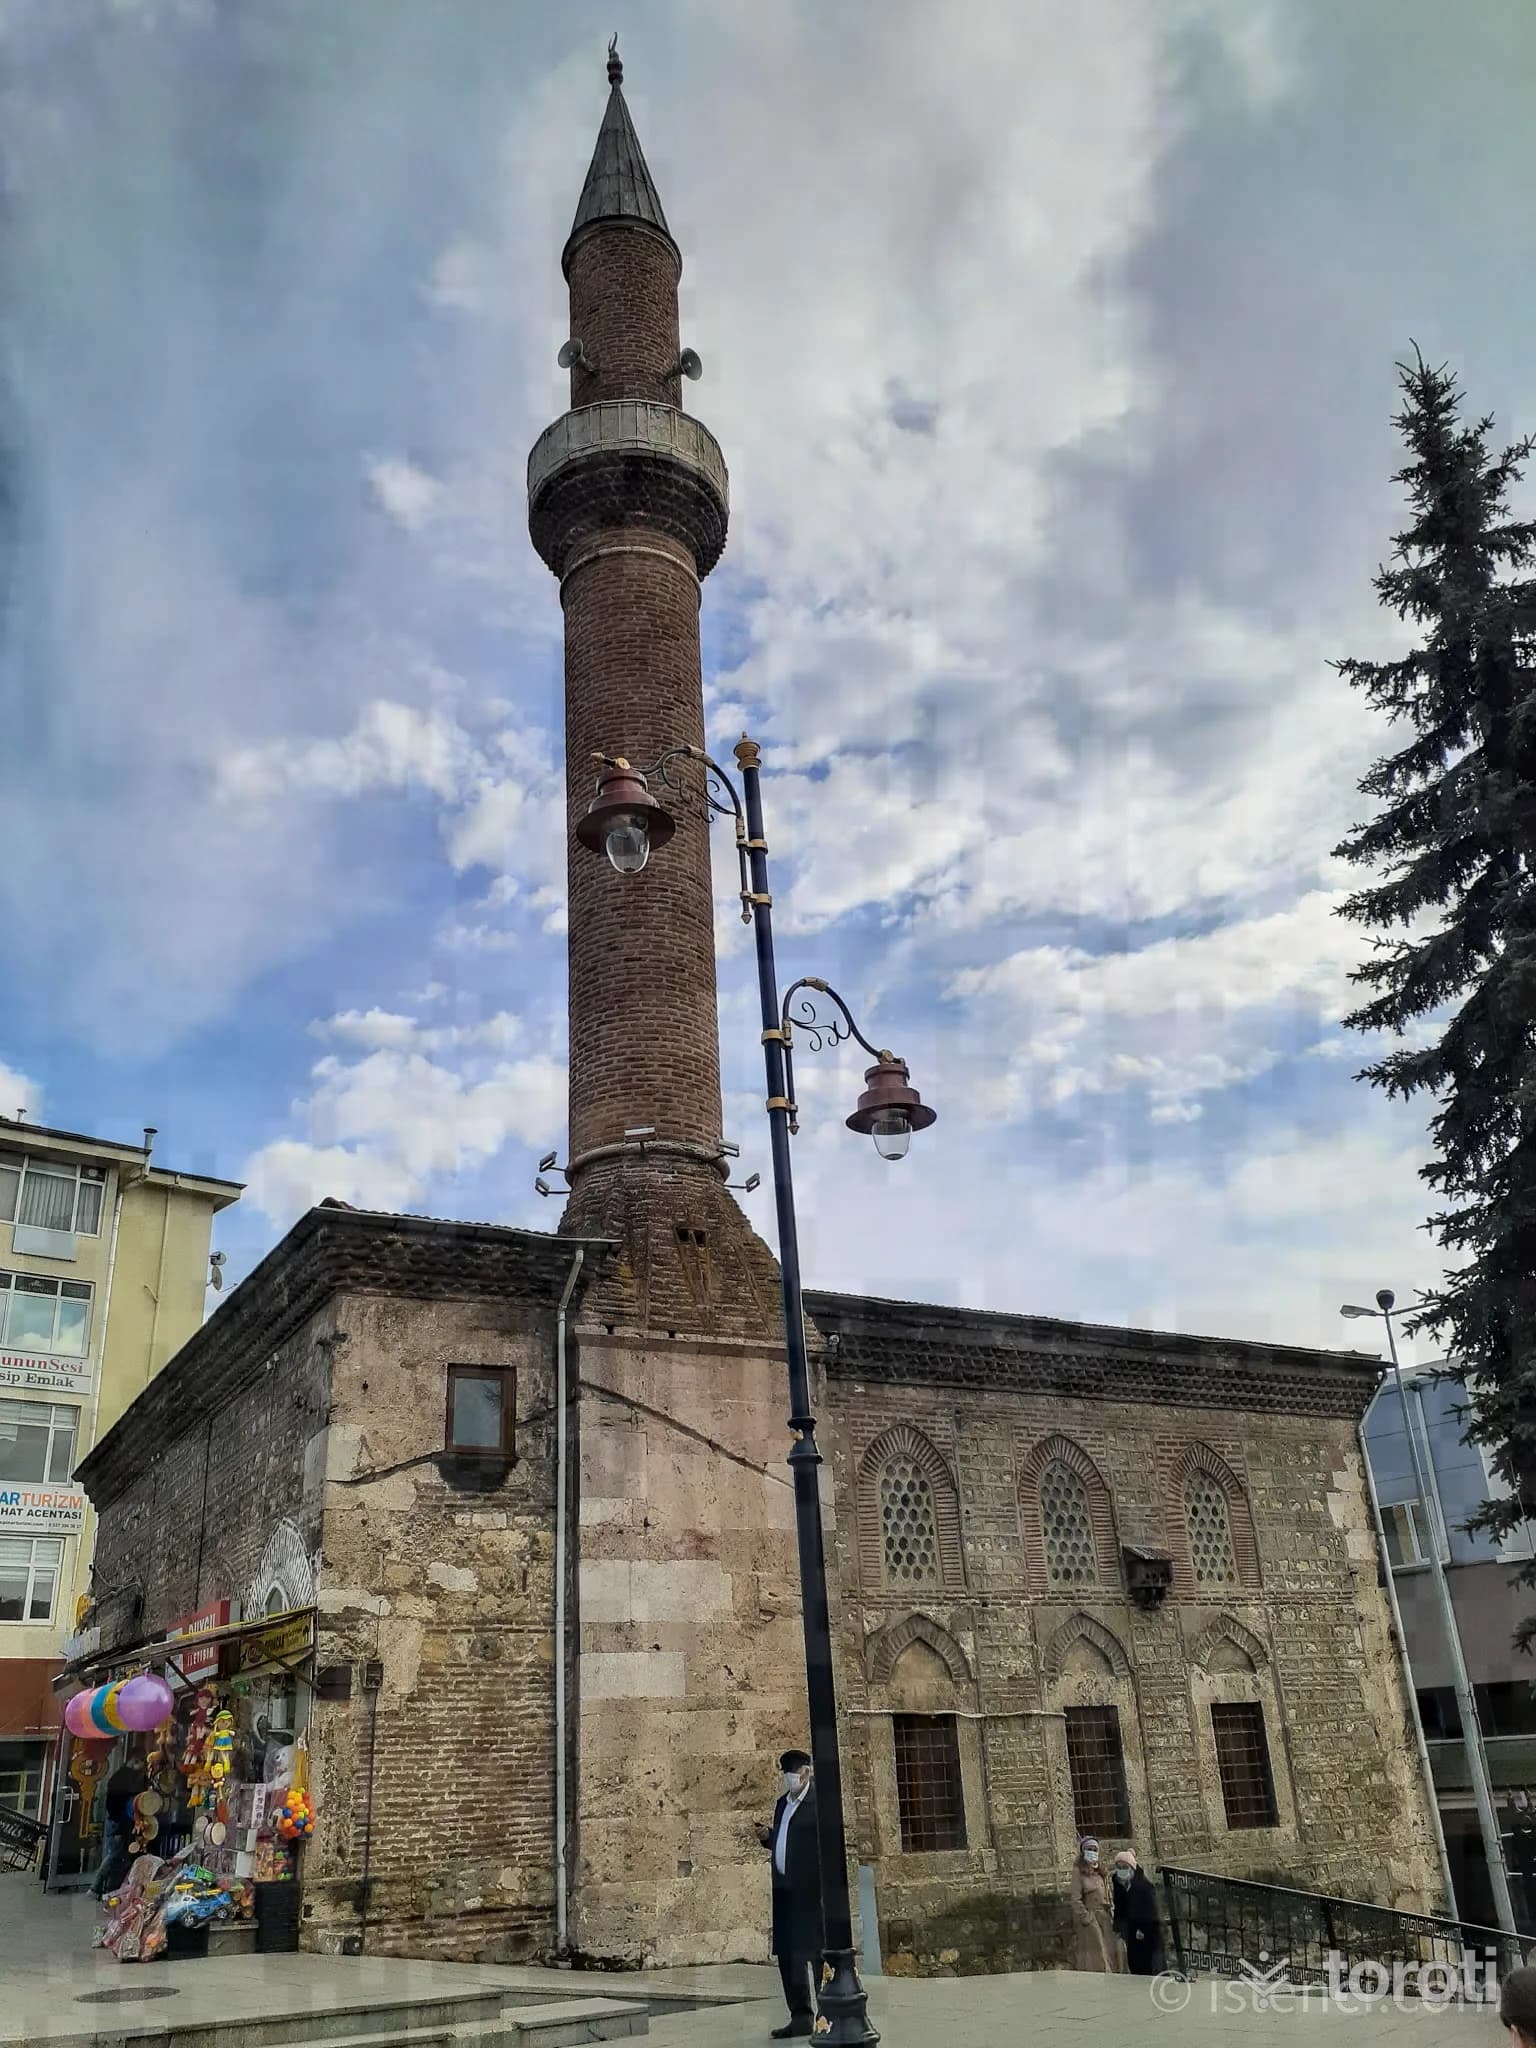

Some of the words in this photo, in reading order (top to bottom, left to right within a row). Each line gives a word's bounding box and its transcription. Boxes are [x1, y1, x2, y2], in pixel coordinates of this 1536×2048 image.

[25, 1372, 75, 1388] Emlak
[0, 1507, 24, 1517] HAT
[27, 1509, 82, 1520] ACENTASI
